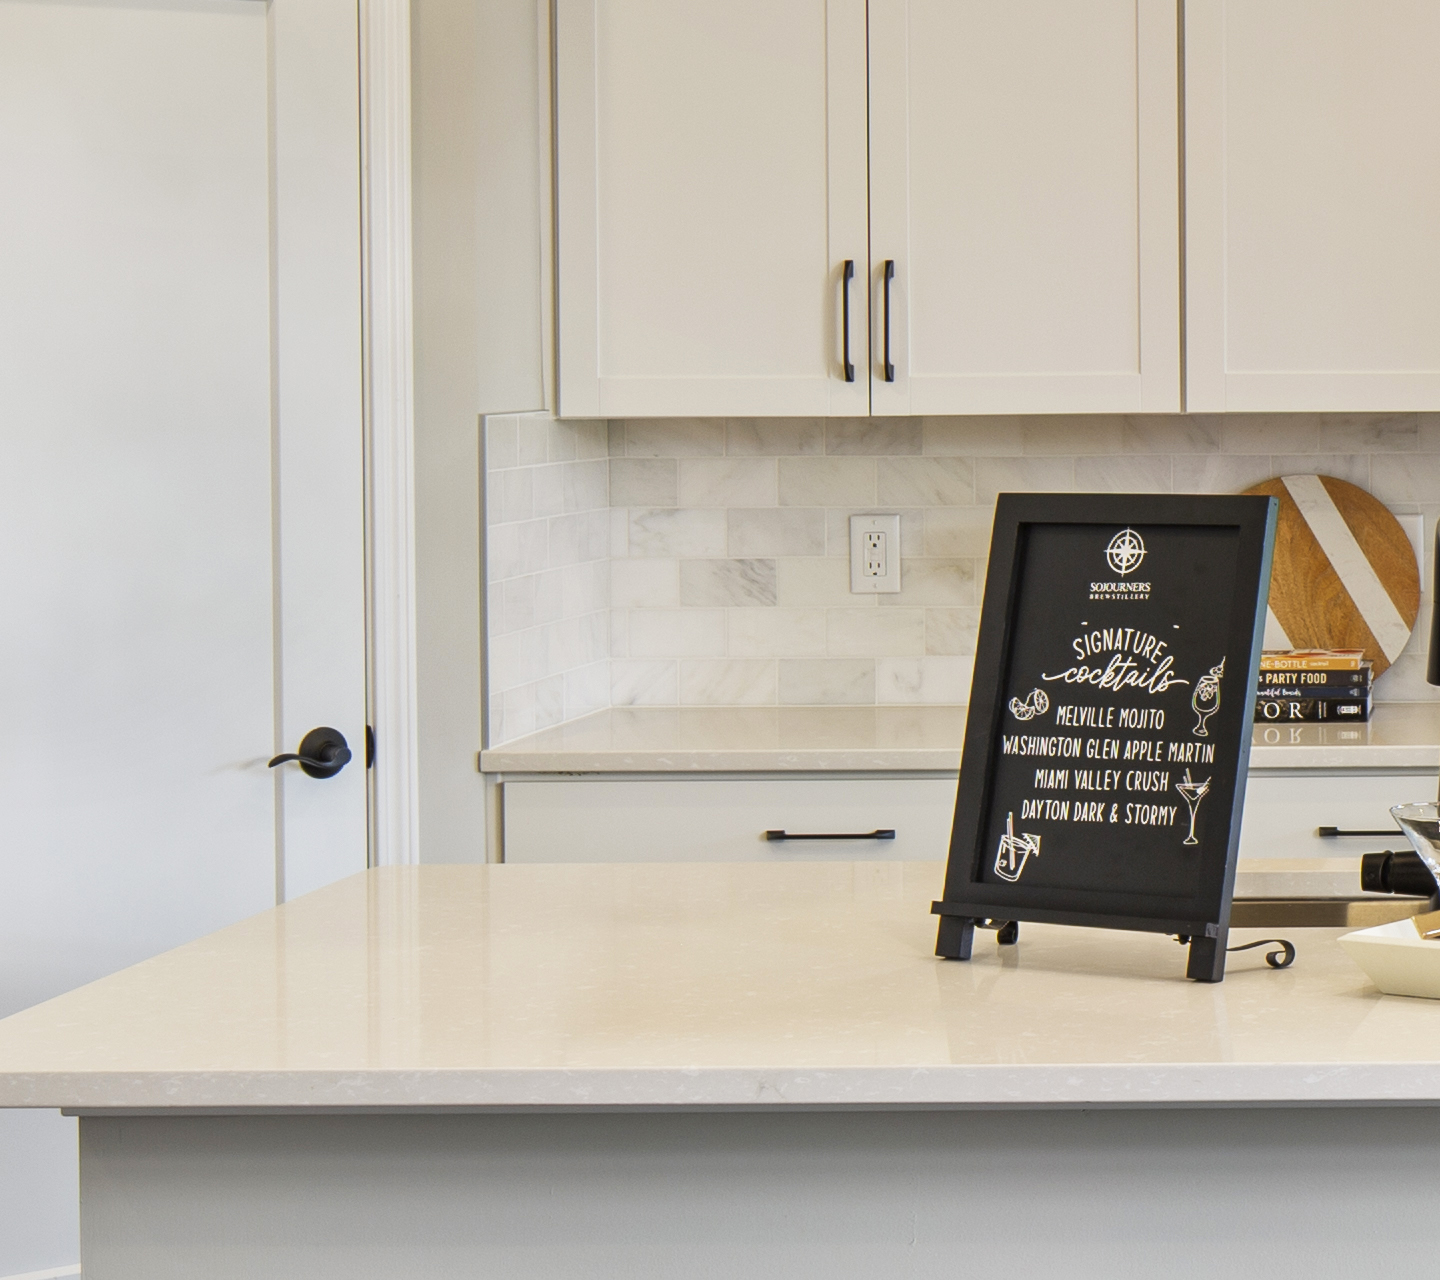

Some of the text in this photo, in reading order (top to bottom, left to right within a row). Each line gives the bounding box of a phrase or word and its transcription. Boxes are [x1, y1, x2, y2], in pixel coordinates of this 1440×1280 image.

[1089, 581, 1152, 593] SOJOURNERS
[1072, 627, 1168, 665] SIGNATURE
[1041, 653, 1190, 695] cocktails
[1260, 660, 1308, 669] NE-BOTTLE
[1265, 672, 1298, 685] PARTY
[1300, 672, 1328, 685] FOOD
[1055, 705, 1165, 730] MELVILLE MOJITO
[1002, 734, 1216, 764] WASHINGTON GLEN APPLE MARTIN
[1034, 768, 1170, 792] MIAMI VALLEY CRUSH
[1020, 798, 1178, 826] DAYTON DARK & STORMY
